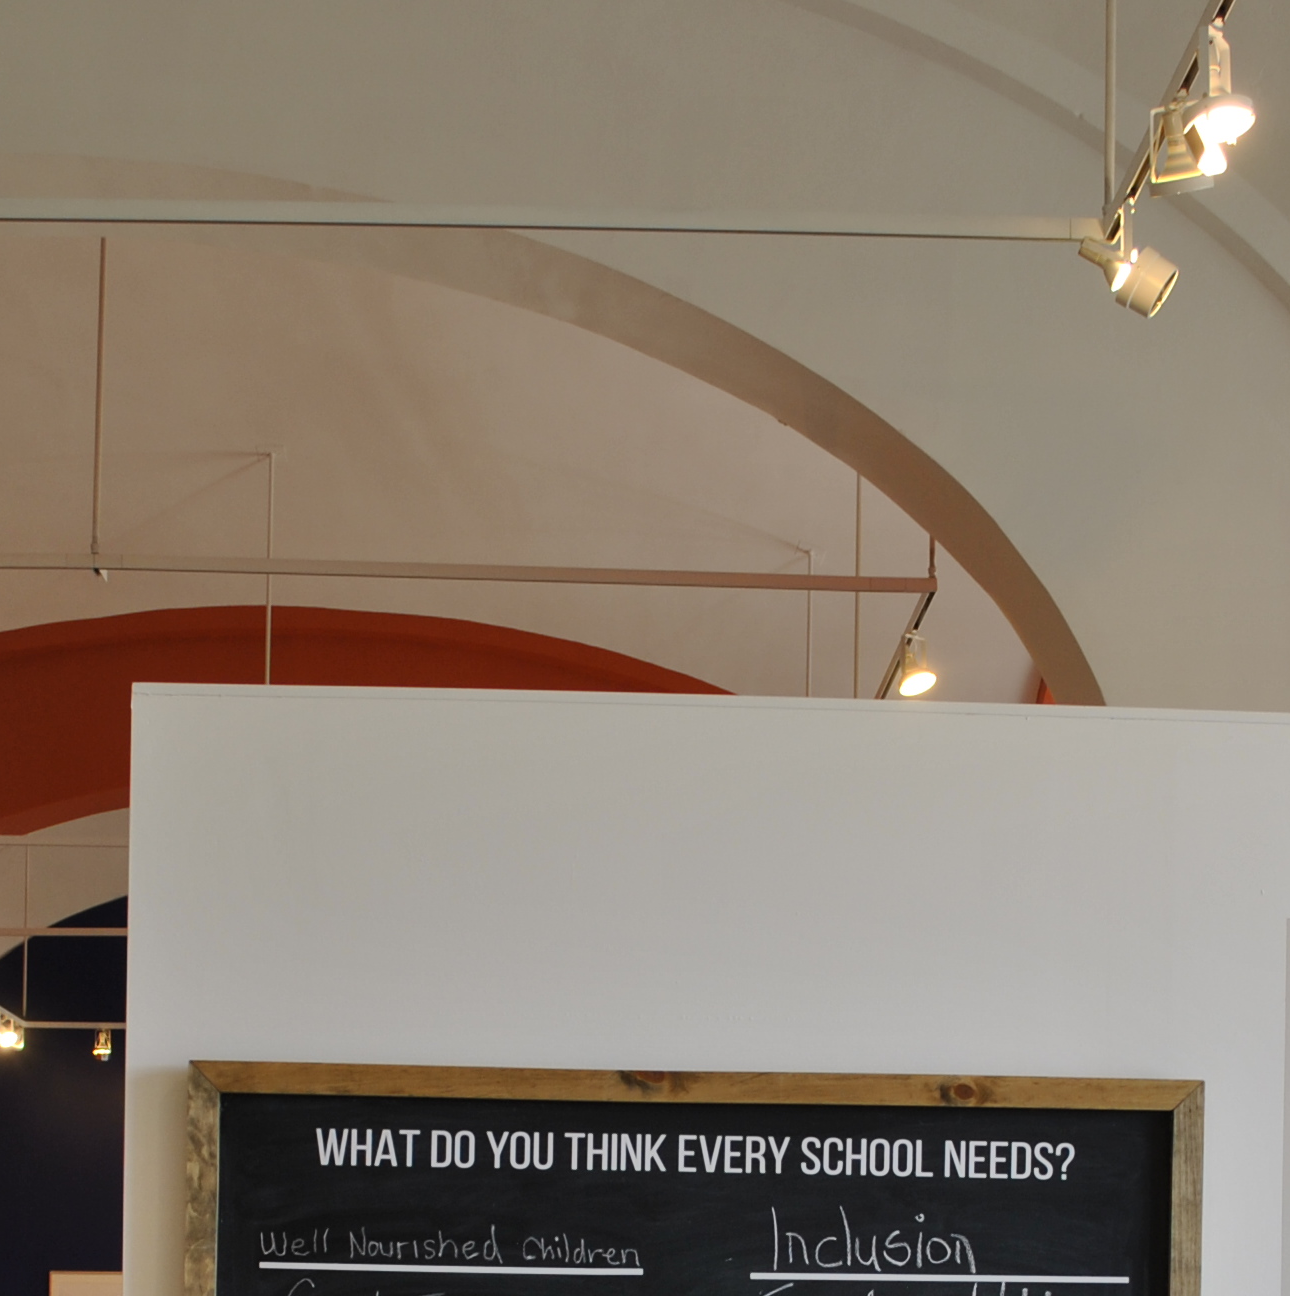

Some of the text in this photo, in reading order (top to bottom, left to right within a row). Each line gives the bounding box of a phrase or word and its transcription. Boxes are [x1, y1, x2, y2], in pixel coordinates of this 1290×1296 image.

[315, 1128, 1076, 1181] WHAT DO YOU THINK EVERY SCHOOL NEEDS?
[260, 1225, 640, 1267] Well Nourished Children
[771, 1205, 976, 1274] Inclusion
